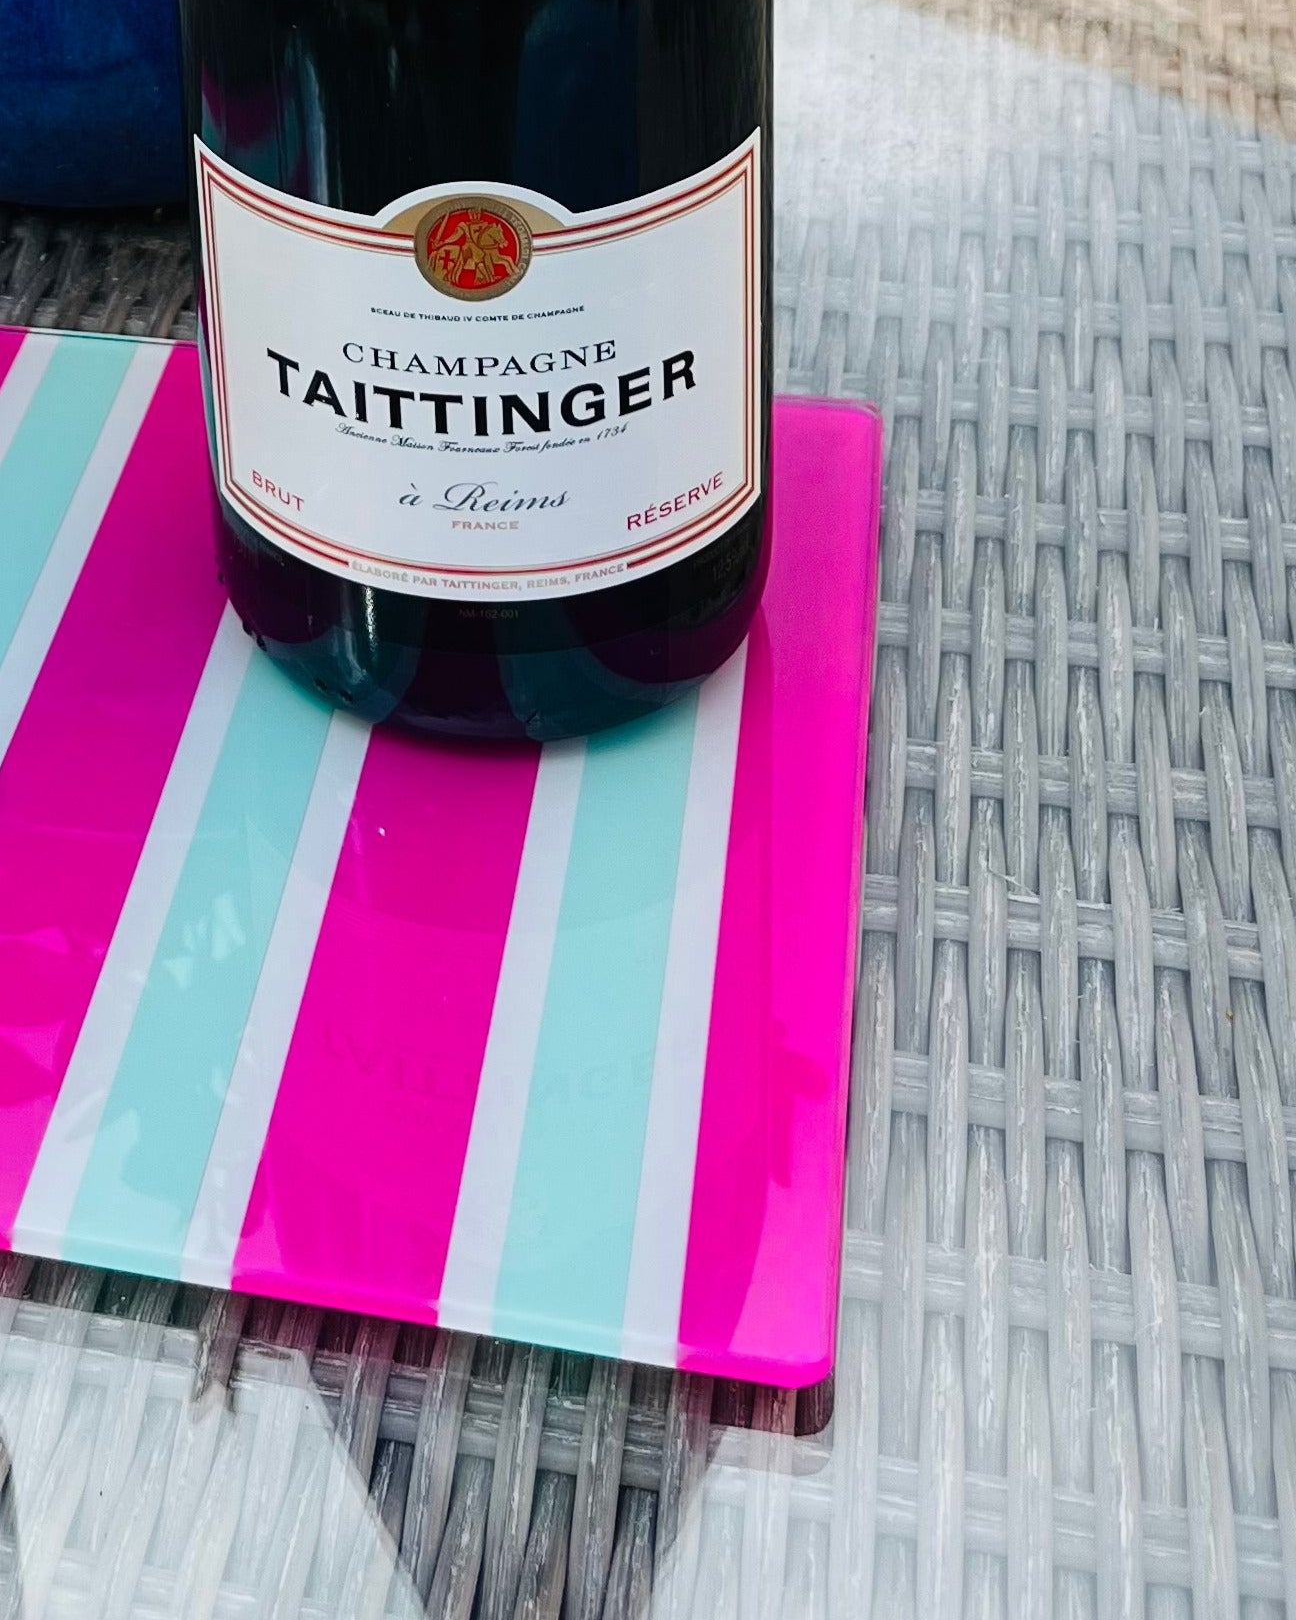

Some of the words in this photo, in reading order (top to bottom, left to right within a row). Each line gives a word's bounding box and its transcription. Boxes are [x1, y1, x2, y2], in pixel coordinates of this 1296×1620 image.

[370, 306, 401, 317] SCEAU
[404, 311, 415, 319] DE
[418, 313, 460, 322] THIBAUD
[475, 314, 508, 322] COMTE
[511, 313, 524, 321] DE
[526, 305, 585, 319] CHAMPAGNE
[342, 339, 617, 377] CHAMPAGNE
[266, 348, 697, 437] TAITTINGER
[335, 422, 387, 443] Ancienne
[390, 434, 434, 451] Maison
[597, 421, 630, 441] 1734
[252, 469, 306, 512] BRUT
[398, 482, 420, 506] à
[432, 482, 571, 513] Reims
[627, 471, 724, 531] RÉSERVE
[451, 520, 520, 530] FRANCE
[352, 560, 409, 582] ÉLABORÉ
[413, 575, 437, 586] PAR
[441, 579, 522, 591] TAITTINGER,
[526, 577, 571, 589] REIMS,
[575, 563, 624, 582] FRANCE
